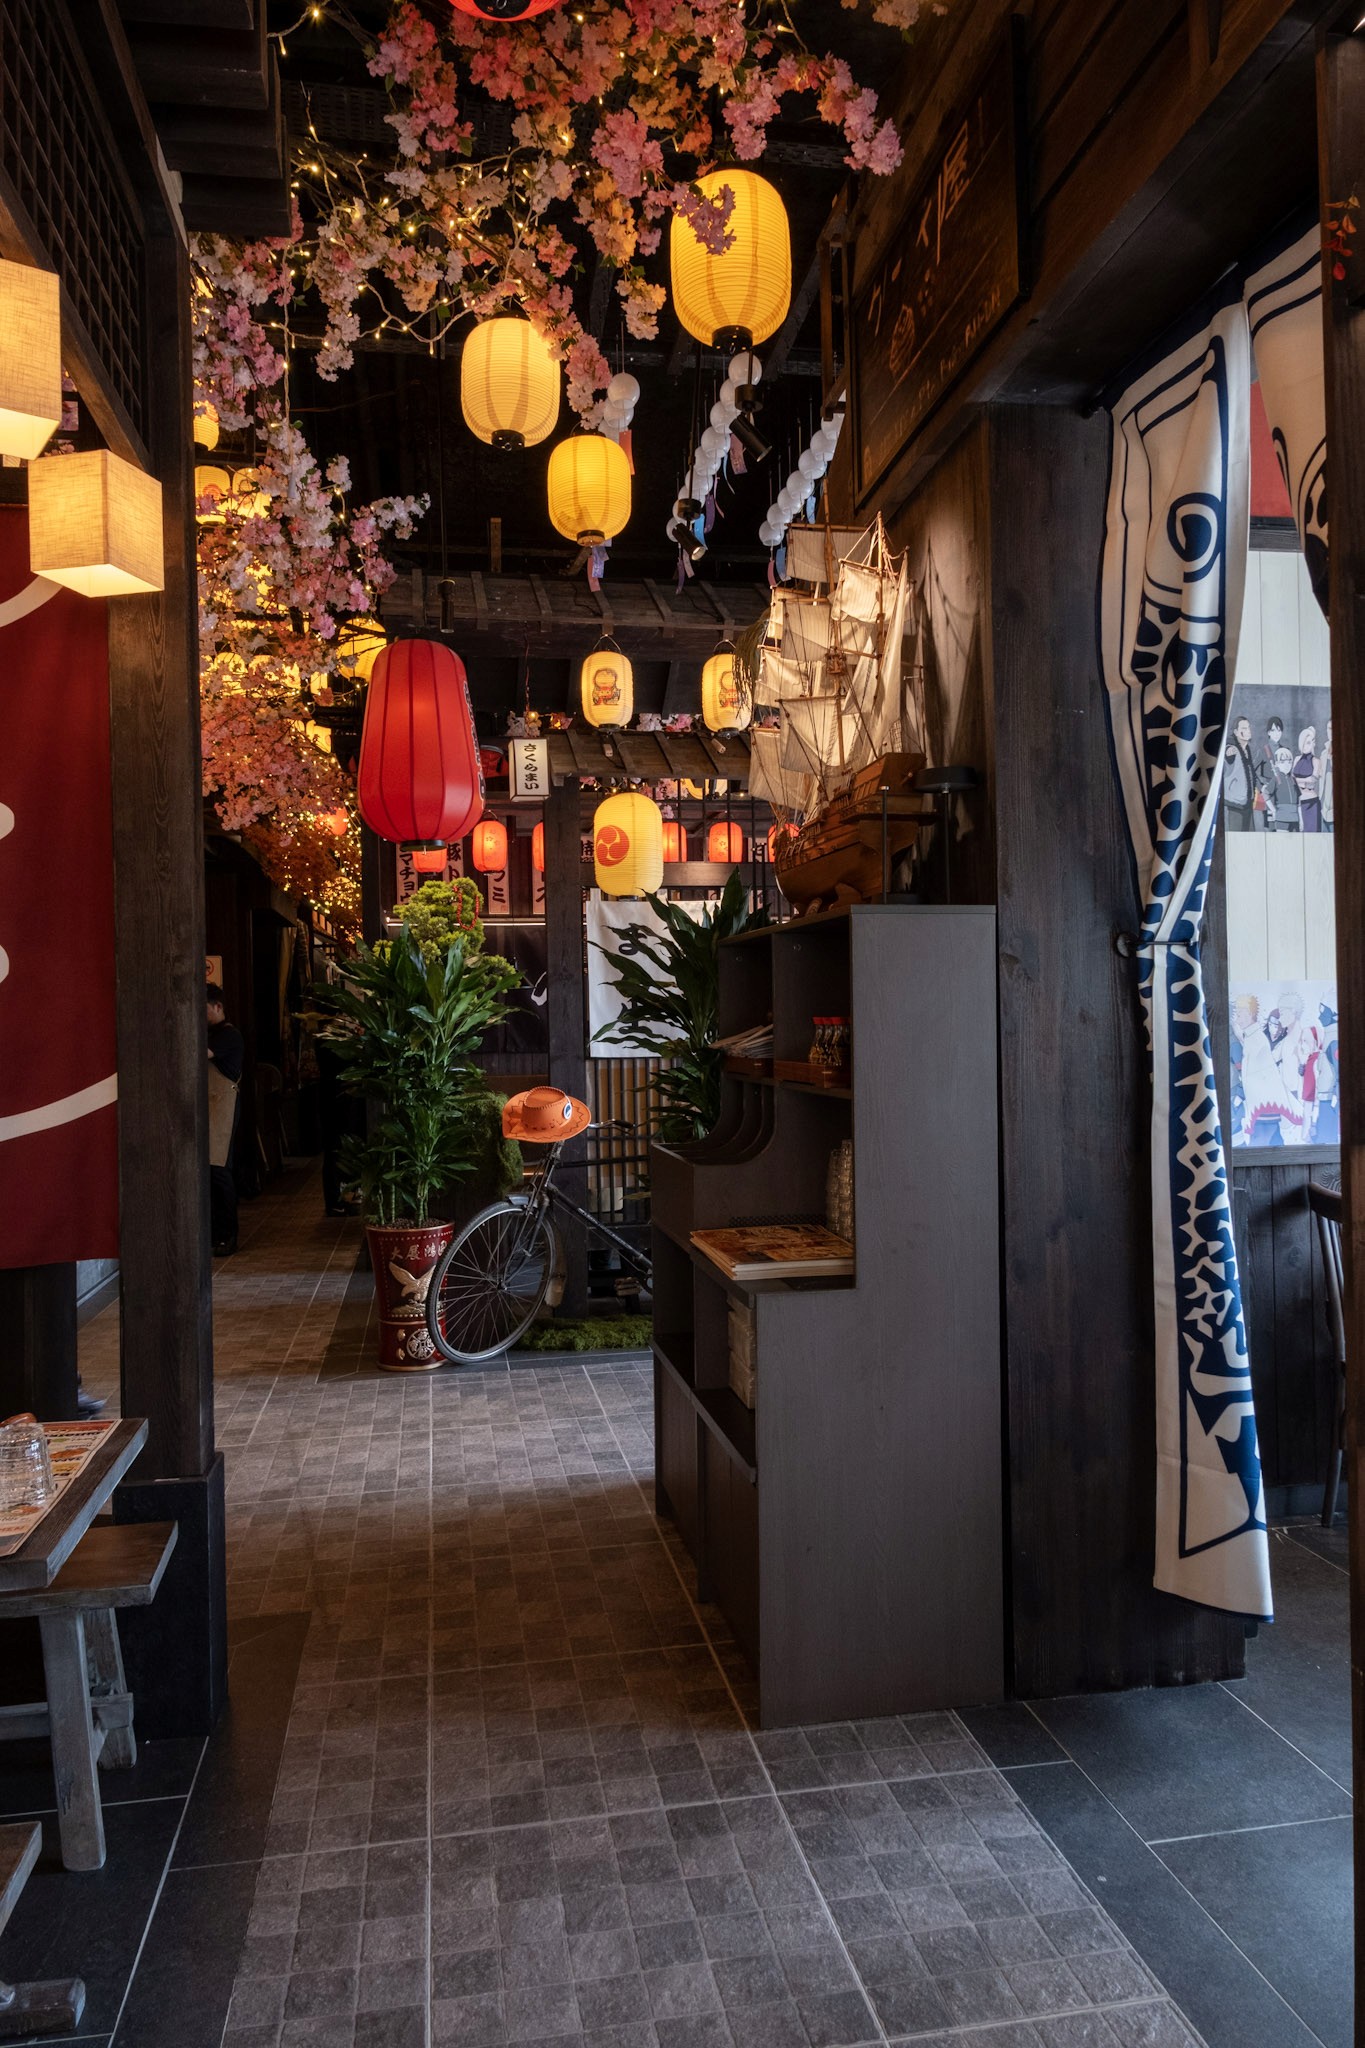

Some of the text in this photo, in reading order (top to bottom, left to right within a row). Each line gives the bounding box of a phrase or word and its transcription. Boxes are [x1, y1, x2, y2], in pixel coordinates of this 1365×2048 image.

[524, 743, 540, 790] さくらまい
